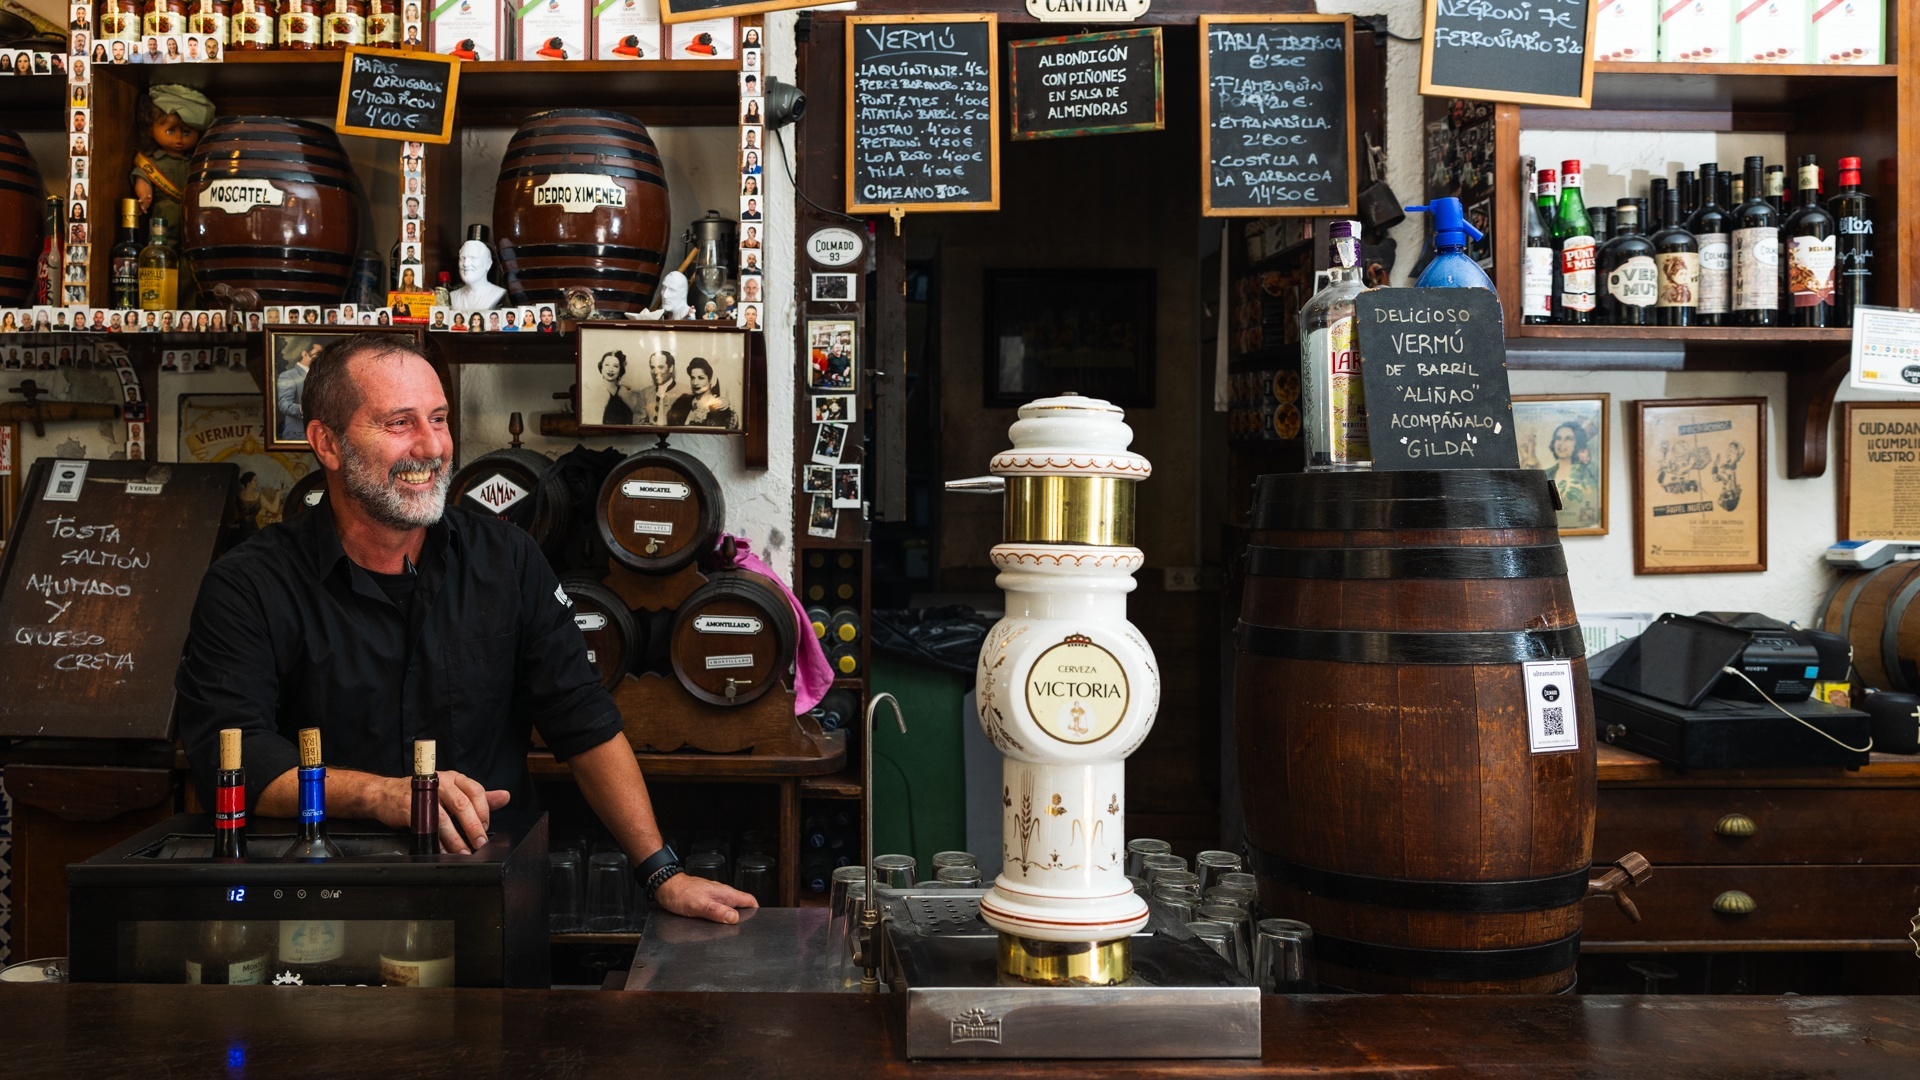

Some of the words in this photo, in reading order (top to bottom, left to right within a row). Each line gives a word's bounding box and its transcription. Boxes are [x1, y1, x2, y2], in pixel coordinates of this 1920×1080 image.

[1045, 0, 1127, 12] CANTINA
[1538, 9, 1577, 29] 7€
[866, 26, 956, 51] VERMÚ
[1208, 31, 1269, 52] TABLA
[1038, 44, 1129, 69] ALBONDIGÓN
[354, 57, 398, 75] PAPAS
[1042, 72, 1067, 87] CON
[1069, 68, 1127, 85] PIÑONES
[1049, 90, 1066, 103] EN
[1070, 88, 1103, 101] SALSA
[1106, 87, 1119, 98] DE
[1048, 101, 1128, 120] ALMENDRAS
[862, 124, 913, 136] LUSTAU
[865, 152, 895, 163] LOA
[1308, 153, 1318, 165] A
[1216, 175, 1235, 187] LA
[1242, 170, 1332, 186] BARBACOA
[210, 186, 271, 204] MOSCATEL
[538, 187, 572, 204] PEDRO
[574, 187, 623, 205] XIMENEZ
[864, 184, 934, 200] CINZANO
[815, 239, 854, 253] COLMADO
[1565, 248, 1594, 261] PUNT
[829, 252, 840, 261] 93
[1391, 329, 1463, 355] VERMÚ
[1385, 364, 1406, 376] DE
[1417, 362, 1479, 376] BARRIL
[195, 425, 254, 445] VERMUT
[1868, 451, 1915, 462] VUESTRO
[480, 481, 516, 507] ATAMÁN
[46, 514, 120, 543] TOSTA
[60, 547, 150, 570] SALMÓN
[26, 573, 132, 597] AHUMADO
[45, 600, 72, 623] Y
[705, 621, 751, 629] AMONTILLADO
[15, 627, 105, 647] QUESO
[54, 652, 134, 672] CREMA
[1058, 665, 1097, 674] CERVEZA
[1033, 681, 1121, 699] VICTORIA
[230, 889, 245, 901] 12
[955, 1023, 997, 1037] Damm
